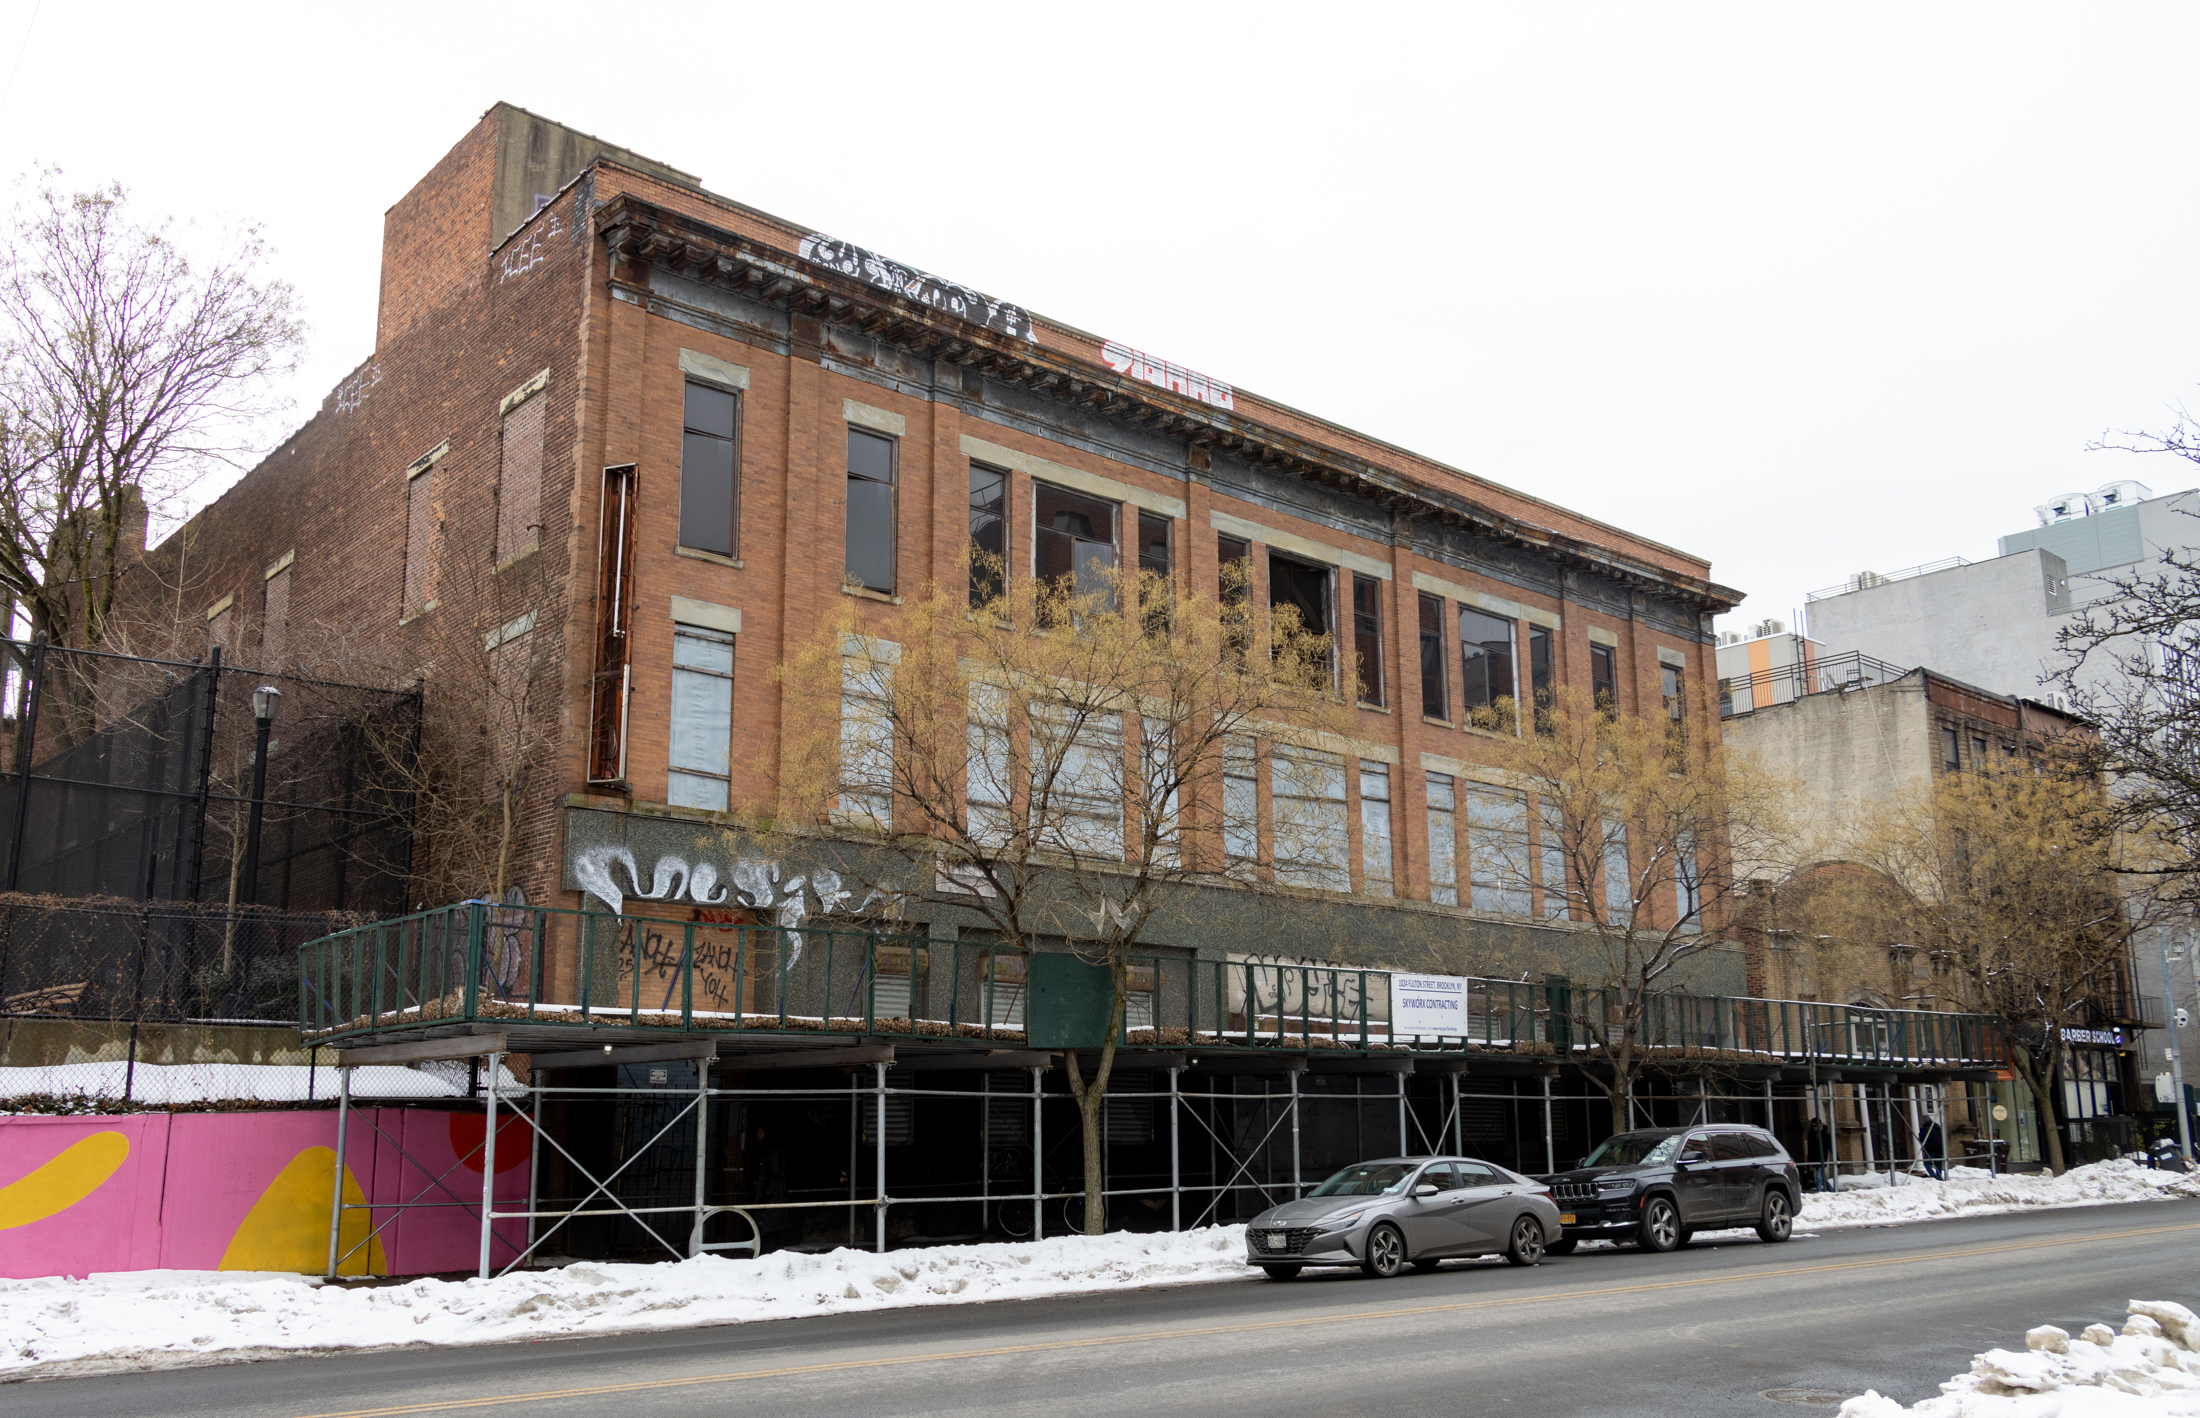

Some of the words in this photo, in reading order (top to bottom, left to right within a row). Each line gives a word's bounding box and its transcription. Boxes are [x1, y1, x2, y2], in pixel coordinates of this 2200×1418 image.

[1425, 999, 1459, 1010] CONTRACTING
[2060, 1028, 2091, 1042] BARBER
[2091, 1030, 2116, 1044] SCHOOL
